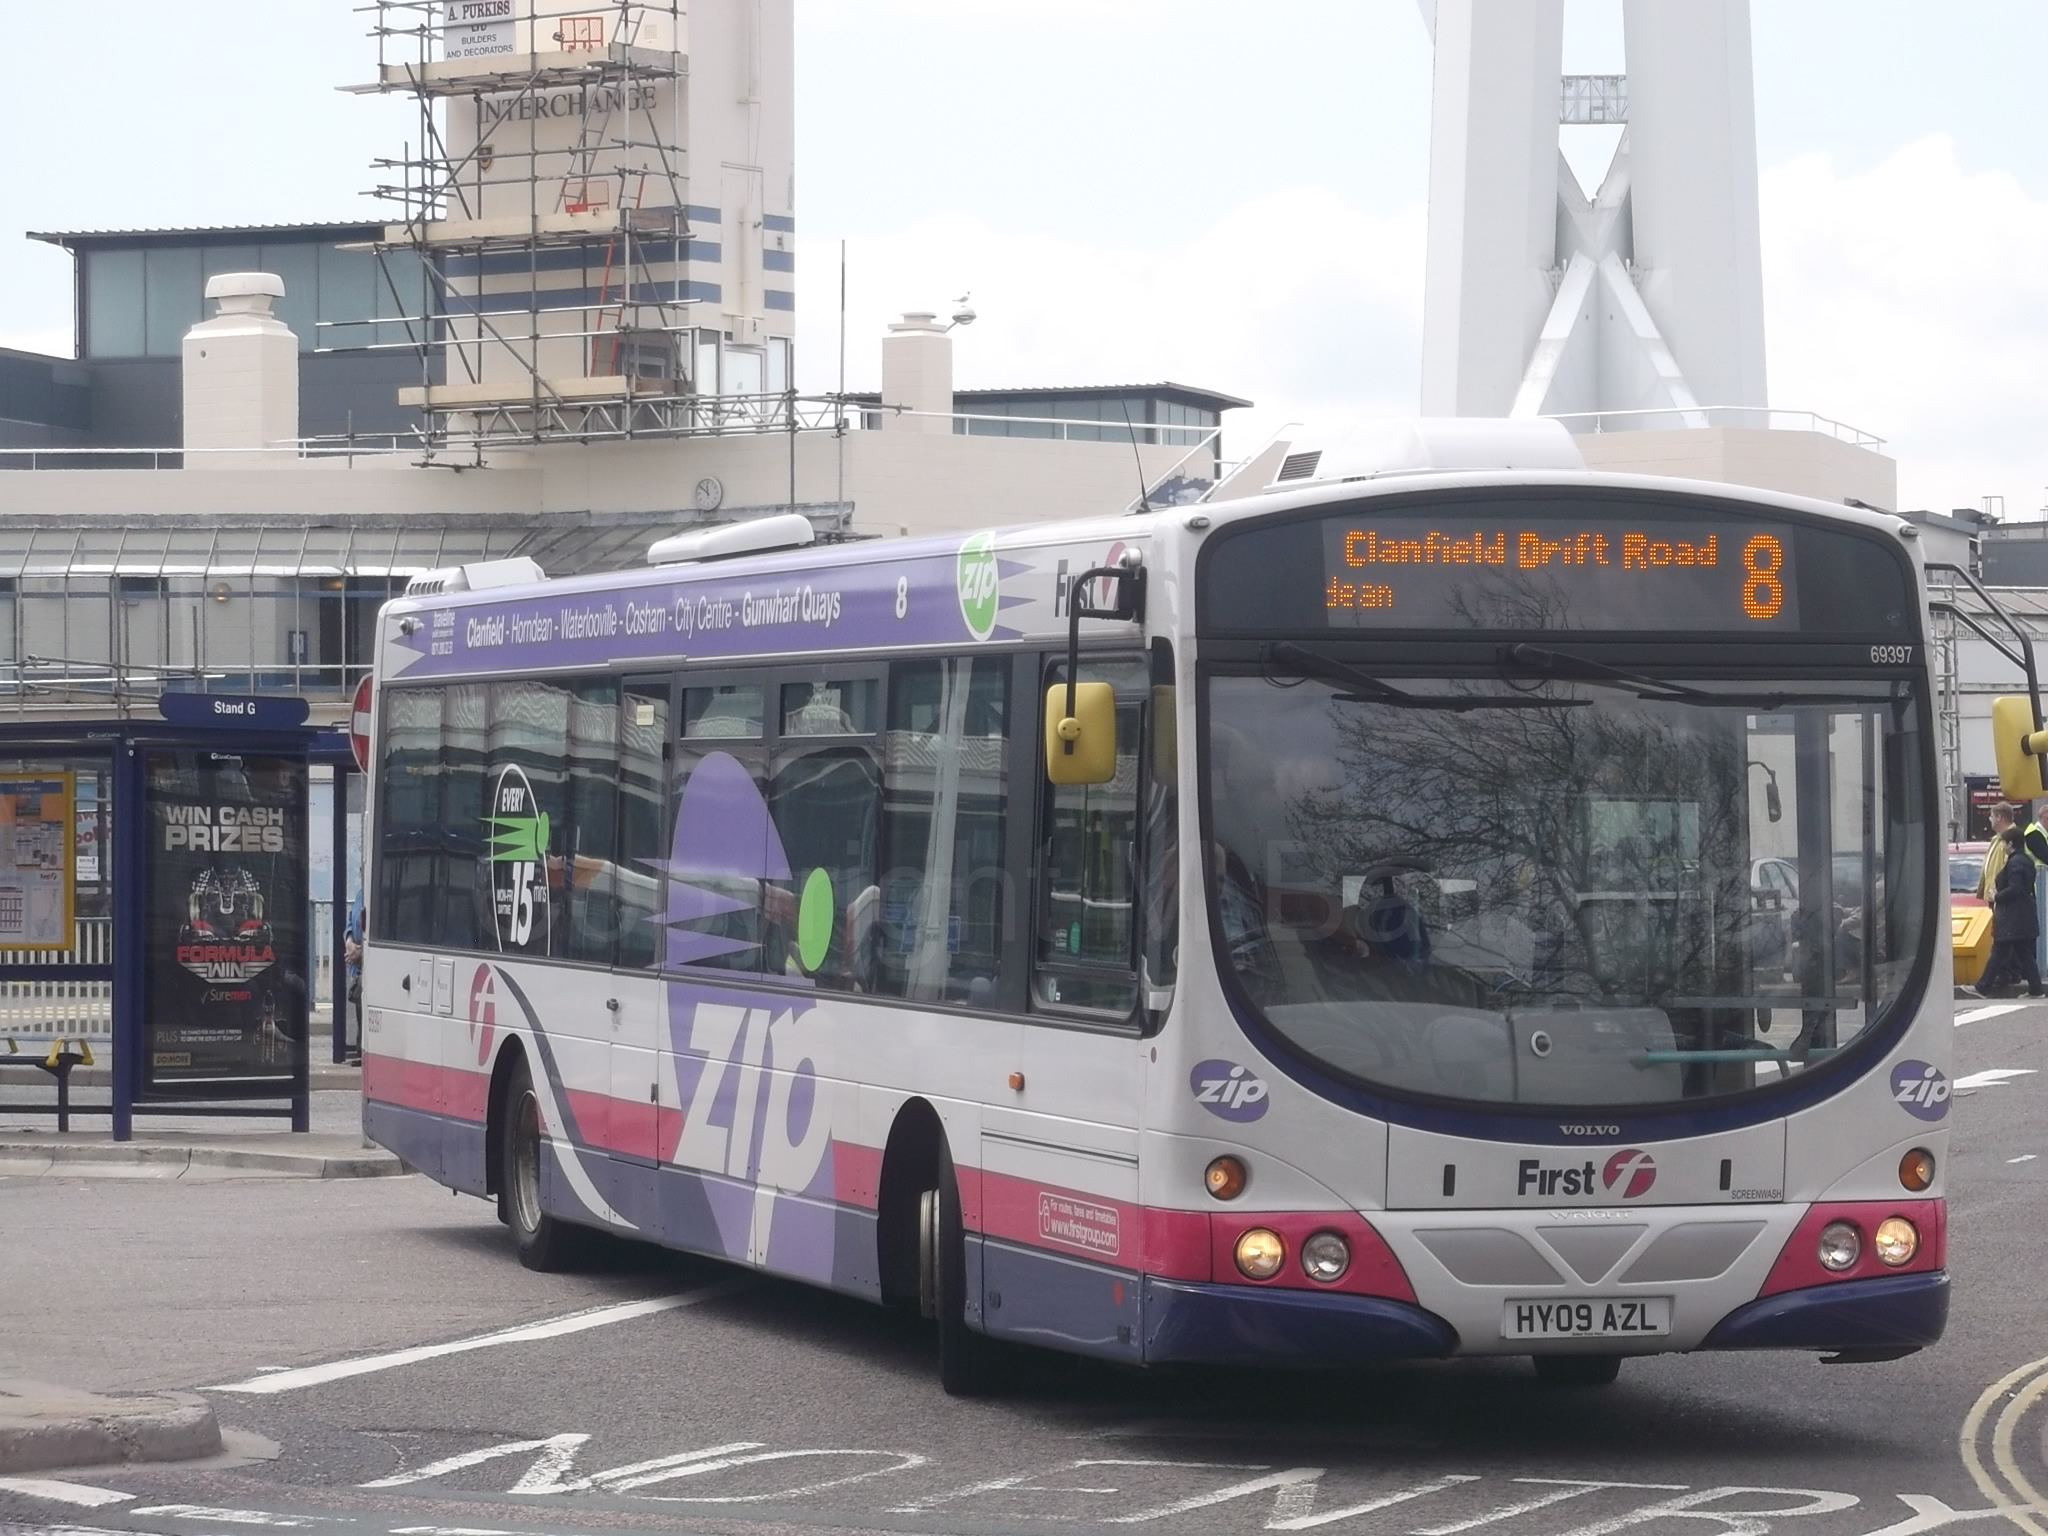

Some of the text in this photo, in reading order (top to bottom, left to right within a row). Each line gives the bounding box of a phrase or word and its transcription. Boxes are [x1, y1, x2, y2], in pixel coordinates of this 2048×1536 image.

[462, 1, 510, 20] PURKISS
[461, 34, 497, 45] BUILDERS
[447, 45, 513, 58] AND DECORATORS
[961, 534, 997, 609] zip
[1346, 530, 1783, 619] Clanfield Drift Road 8
[466, 576, 908, 648] Clanfield Horndean Waterlooville Cosham City Centre Gunwharf Quays 8
[1870, 646, 1913, 664] 69397
[214, 701, 256, 715] Stand G
[501, 787, 525, 812] EVERY
[166, 806, 284, 826] WIN CASH
[165, 825, 284, 852] PRIZES
[510, 862, 535, 946] 15
[534, 880, 547, 903] mins
[176, 945, 276, 963] FORMULA
[206, 962, 245, 978] WIN
[156, 1030, 178, 1043] PLUS
[1193, 1066, 1268, 1108] zip
[1894, 1066, 1951, 1108] zip
[1559, 1125, 1620, 1136] VOLVO
[1517, 1159, 1596, 1195] First
[1731, 1188, 1783, 1199] SCREENWASH
[1085, 1208, 1094, 1220] and
[1548, 1209, 1633, 1220] WRIGHT
[1050, 1218, 1117, 1249] www.firstgroup.com
[1517, 1303, 1658, 1333] HY09 AZL
